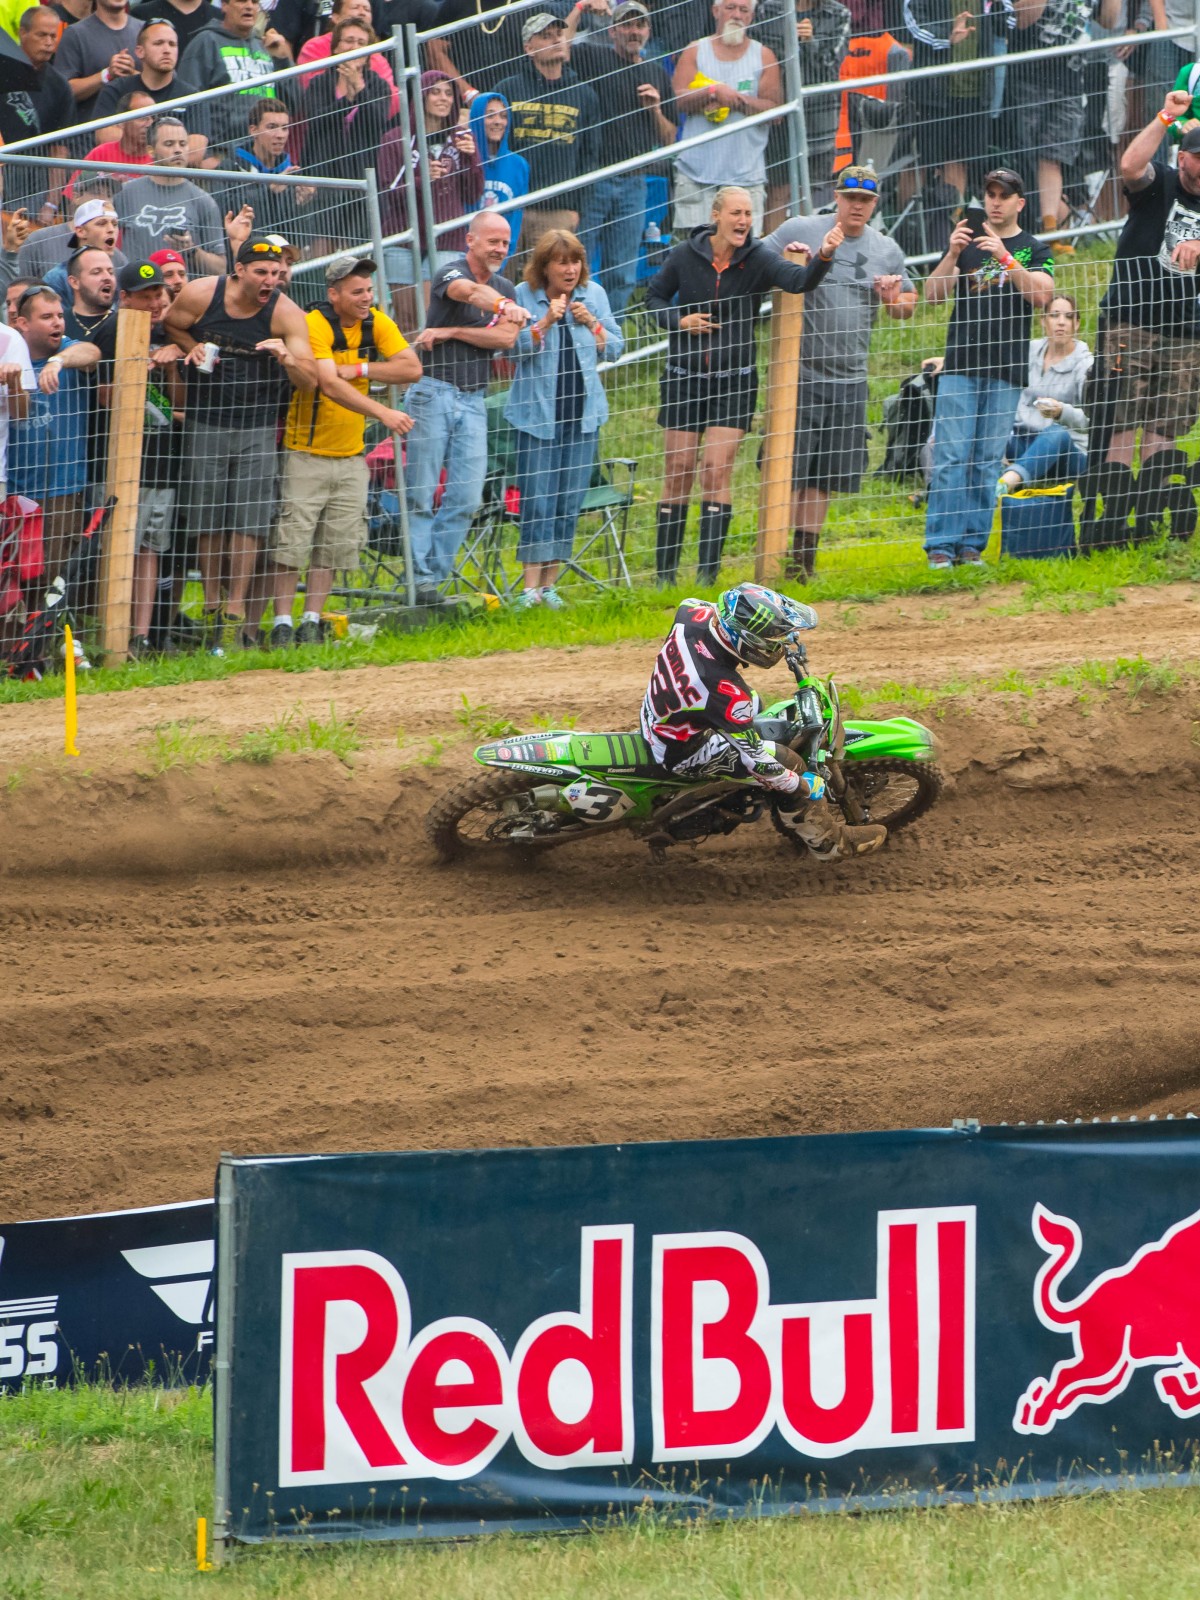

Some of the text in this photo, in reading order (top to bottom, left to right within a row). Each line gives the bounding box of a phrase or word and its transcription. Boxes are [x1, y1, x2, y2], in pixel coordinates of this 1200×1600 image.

[664, 629, 703, 708] TOMAC
[845, 734, 865, 745] TOMAC
[511, 763, 564, 776] DUNLOP
[573, 786, 623, 821] 3
[279, 1205, 977, 1487] Red Bull
